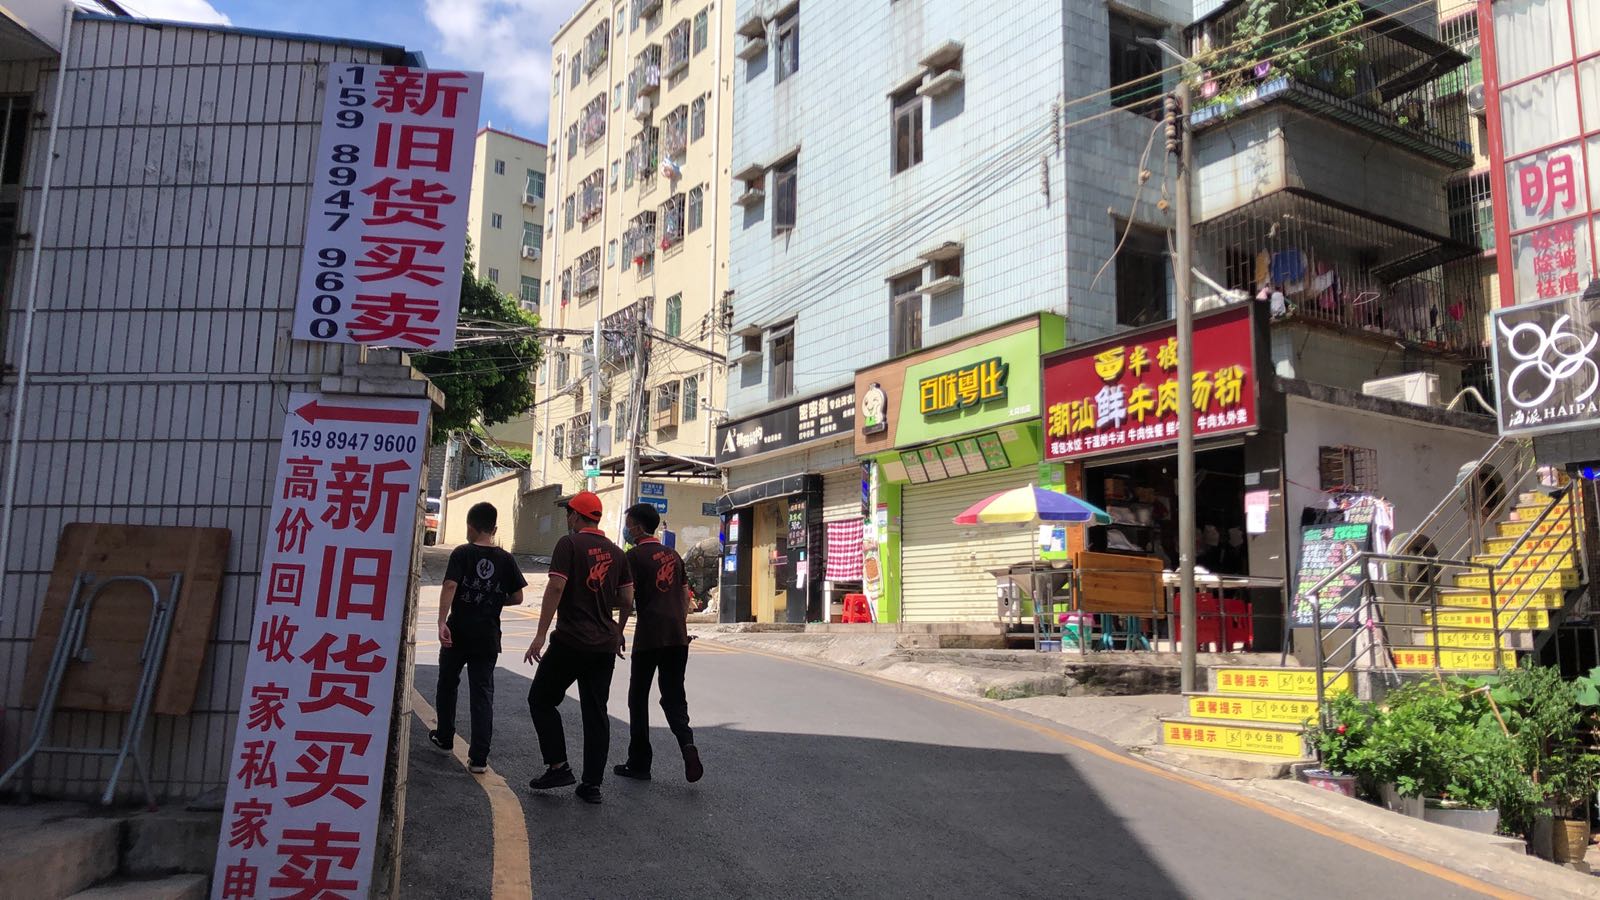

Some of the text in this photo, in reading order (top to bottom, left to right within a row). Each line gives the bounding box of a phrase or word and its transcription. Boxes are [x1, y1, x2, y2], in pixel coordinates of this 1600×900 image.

[1518, 153, 1578, 217] 明
[308, 65, 367, 341] 159 8947 9600
[345, 65, 470, 349] 新旧货买卖
[920, 357, 1006, 415] 百味粤比
[1048, 363, 1248, 437] 潮汕鲜牛肉汤粉
[290, 428, 417, 454] 159 8947 9600
[1127, 423, 1164, 442] 牛肉快餐
[1197, 408, 1248, 431] 牛肉丸外卖
[256, 455, 324, 664] 高价回收
[1471, 652, 1513, 662] 小心阶
[269, 455, 413, 900] 新旧货买卖
[1222, 672, 1269, 688] 温馨提示
[1196, 699, 1243, 715] 温馨提示
[1270, 703, 1310, 714] 小心台阶
[1170, 726, 1217, 743] 温馨提示
[1244, 731, 1285, 744] 小心台阶
